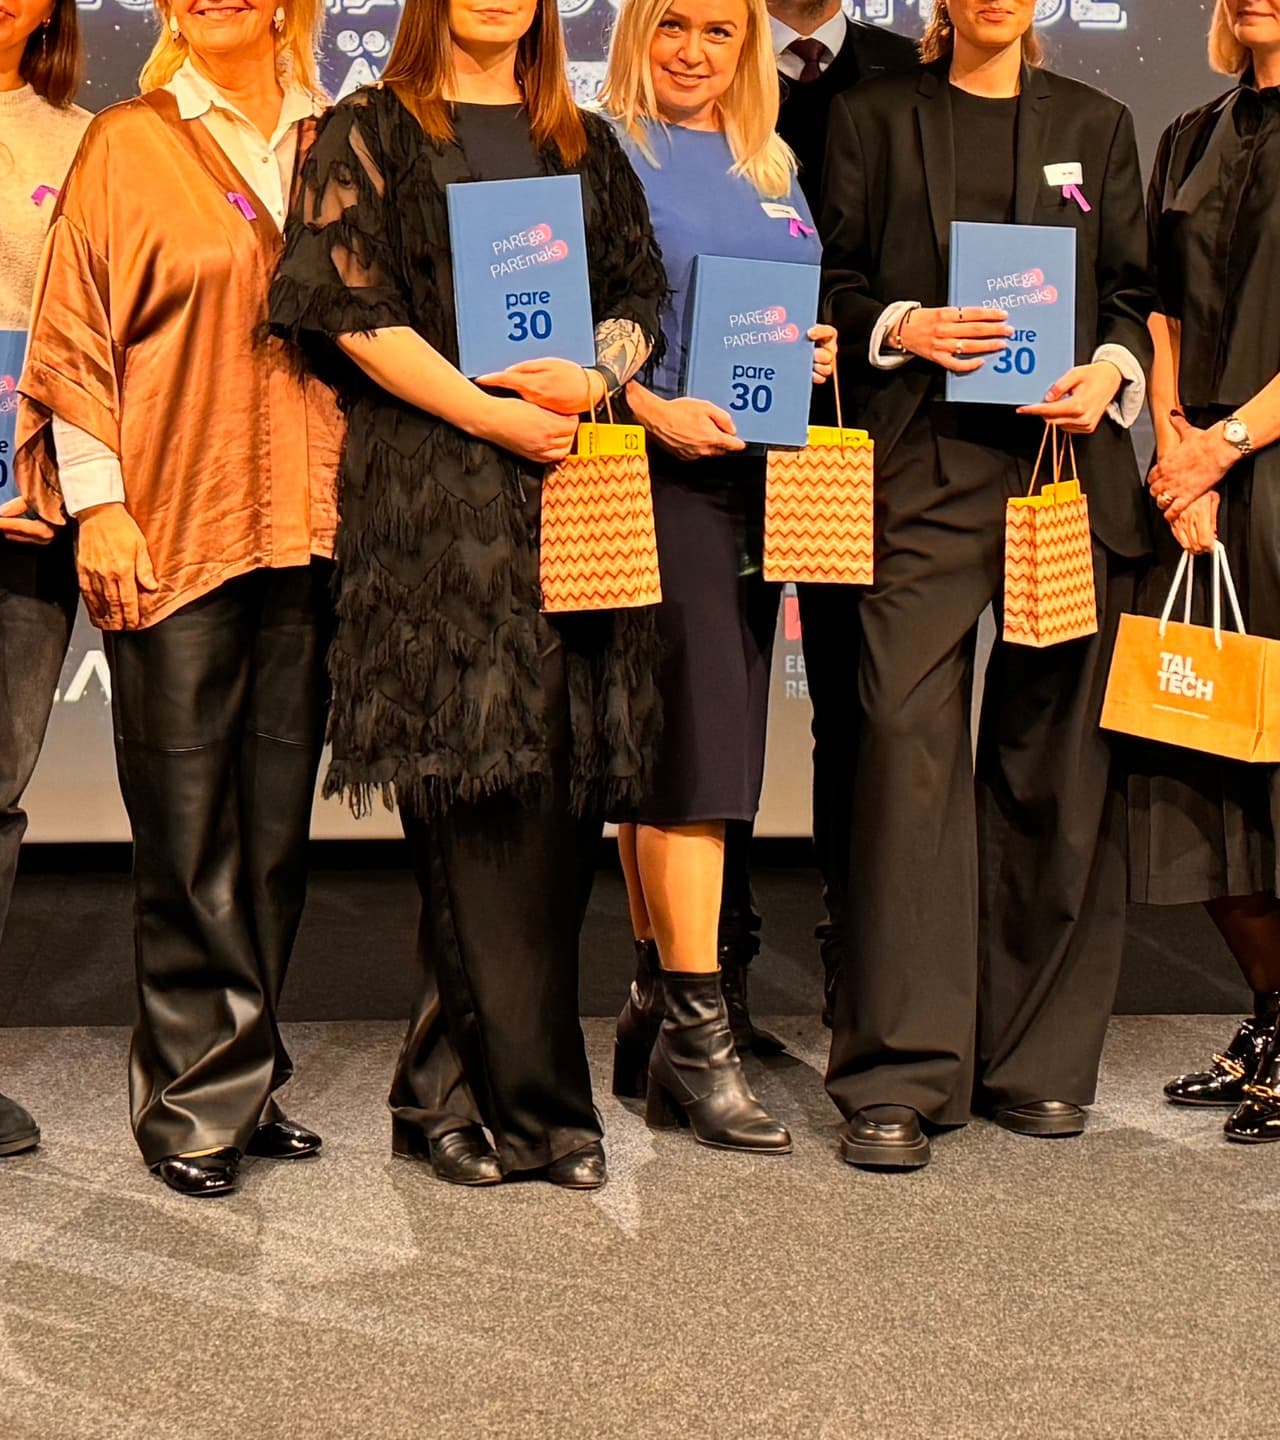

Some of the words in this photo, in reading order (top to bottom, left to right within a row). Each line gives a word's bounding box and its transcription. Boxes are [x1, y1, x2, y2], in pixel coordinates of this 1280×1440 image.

[492, 227, 545, 256] PAREga
[489, 244, 563, 279] PAREmaks
[986, 271, 1038, 291] PAREga
[505, 290, 551, 310] pare
[507, 309, 552, 342] 30
[729, 309, 780, 328] PAREga
[723, 326, 794, 349] PAREmaks
[732, 364, 775, 380] pare
[993, 347, 1036, 375] 30
[729, 382, 773, 413] 30
[1159, 651, 1197, 677] TAL
[1157, 671, 1214, 701] TECH
